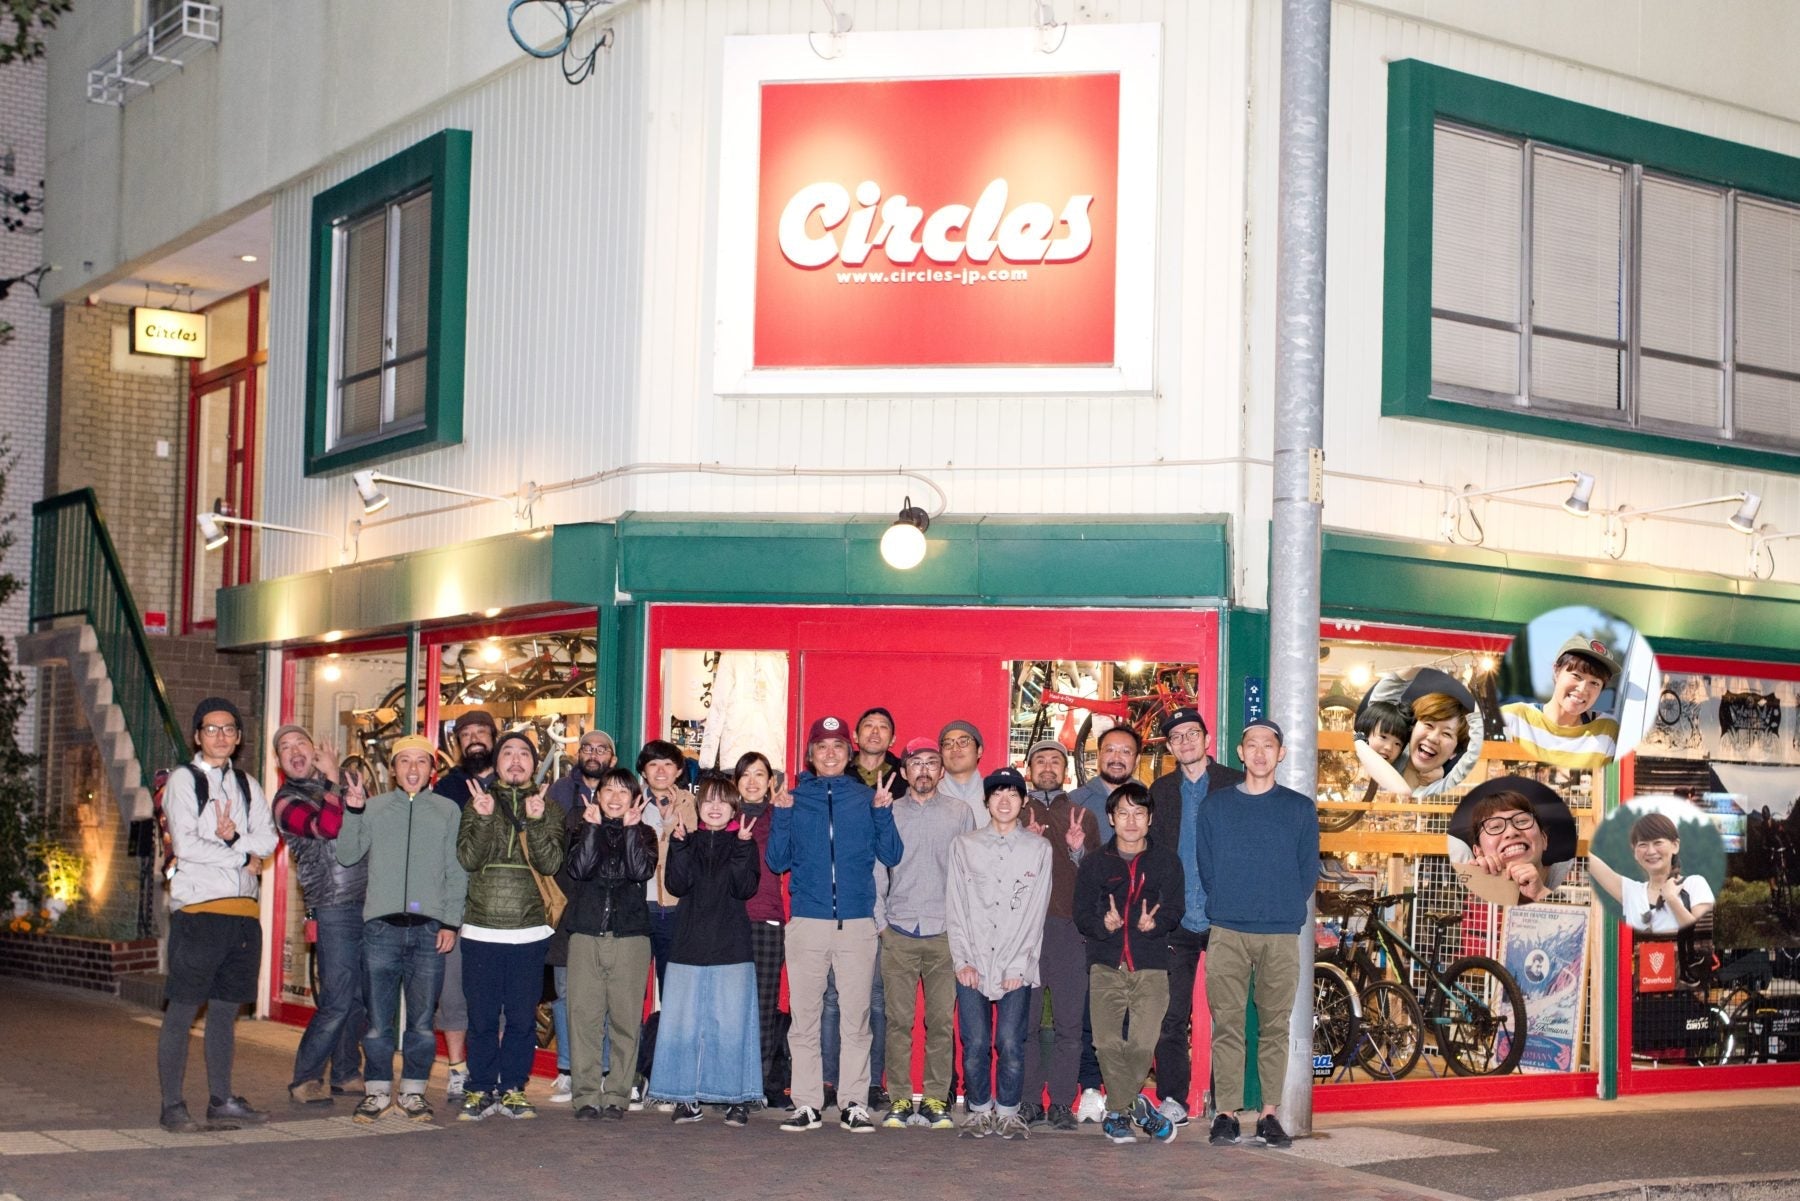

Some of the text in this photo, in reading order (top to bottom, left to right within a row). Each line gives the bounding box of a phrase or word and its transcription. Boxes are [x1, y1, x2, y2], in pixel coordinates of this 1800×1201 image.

[779, 178, 1094, 270] Circles
[836, 268, 1029, 285] www.circles-jp.com
[145, 325, 197, 342] Circles
[1641, 976, 1672, 985] Cleverhood
